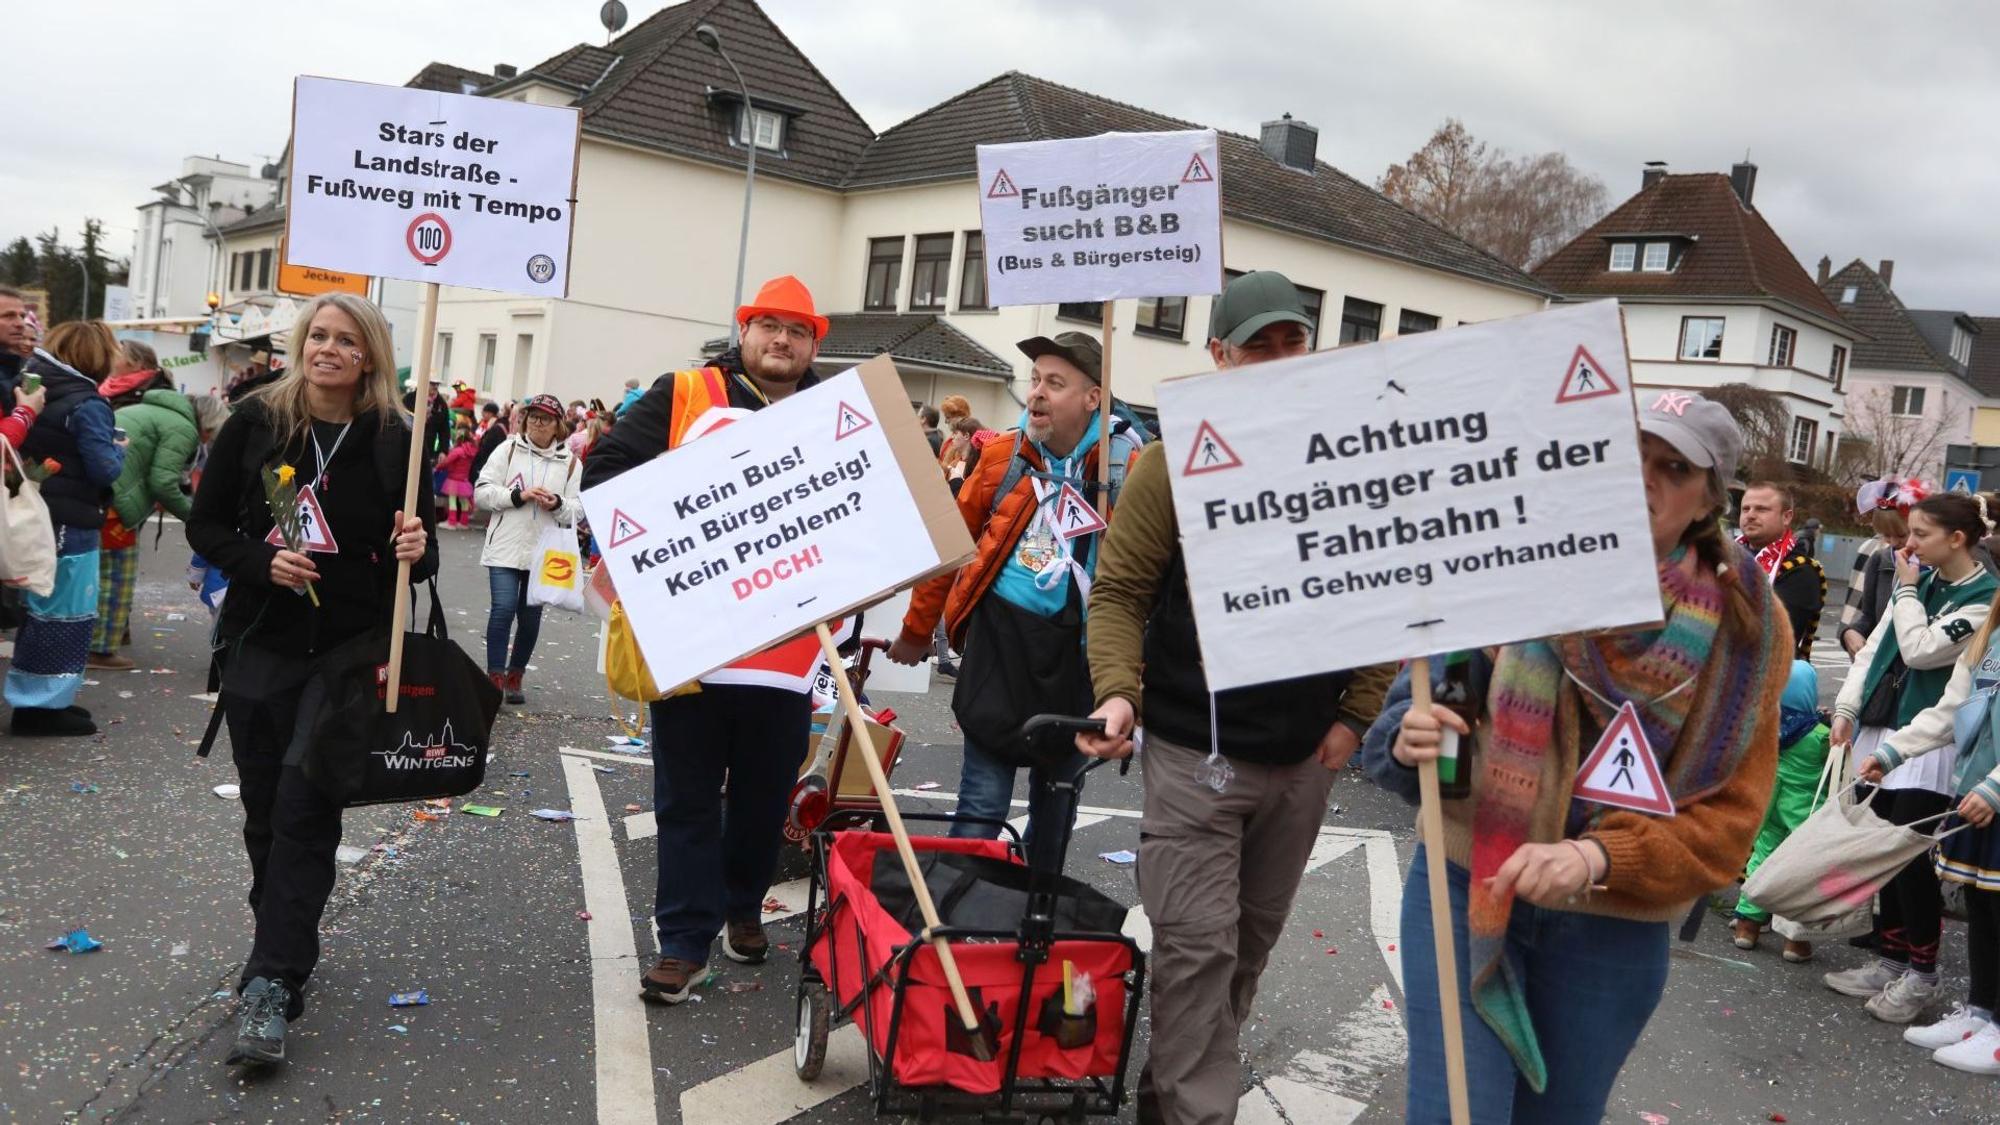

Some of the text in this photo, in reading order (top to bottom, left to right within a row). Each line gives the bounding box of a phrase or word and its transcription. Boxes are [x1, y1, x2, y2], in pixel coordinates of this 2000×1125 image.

[379, 122, 498, 154] Stars der
[355, 150, 500, 185] Landstraße
[307, 175, 562, 224] Fußweg mit Tempo
[1021, 184, 1180, 211] Fußgänger
[417, 226, 442, 251] 100
[1023, 212, 1180, 243] sucht B&B
[302, 268, 346, 286] Jecken
[535, 263, 548, 273] 70
[997, 244, 1202, 275] (Bus & Bürgersteig)
[1305, 410, 1489, 465] Achtung
[673, 446, 805, 520] Kein Bus!
[1204, 438, 1611, 530] Fußgänger auf der
[631, 450, 873, 575] Kein Bürgersteig!
[1296, 502, 1500, 562] Fahrbahn
[665, 491, 864, 597] Kein Problem?
[731, 544, 824, 602] DOCH!
[1222, 530, 1620, 614] kein Gehweg vorhanden
[384, 754, 475, 770] WINTGENS
